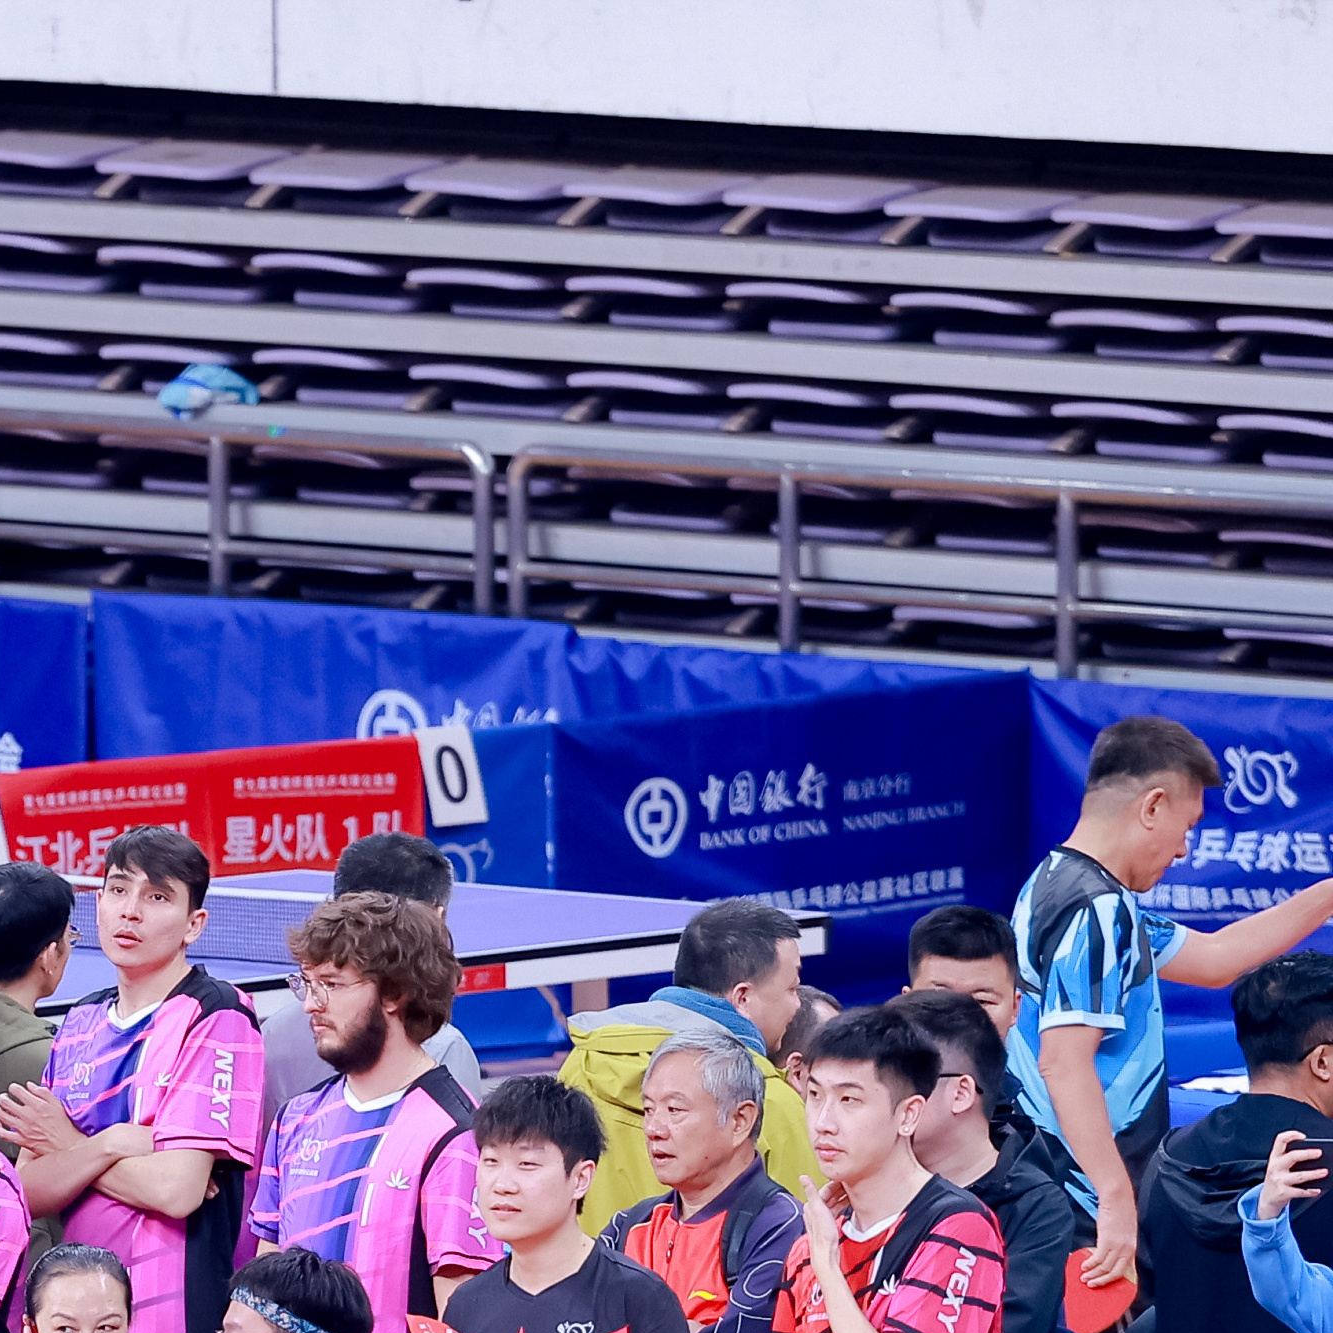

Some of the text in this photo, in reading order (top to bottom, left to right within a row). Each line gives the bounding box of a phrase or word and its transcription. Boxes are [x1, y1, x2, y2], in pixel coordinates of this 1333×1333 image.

[436, 744, 468, 804] 0
[222, 811, 330, 867] 星火队
[699, 800, 966, 850] BANK OF CHINA NANJING BRANCH
[209, 1048, 234, 1131] NEXY
